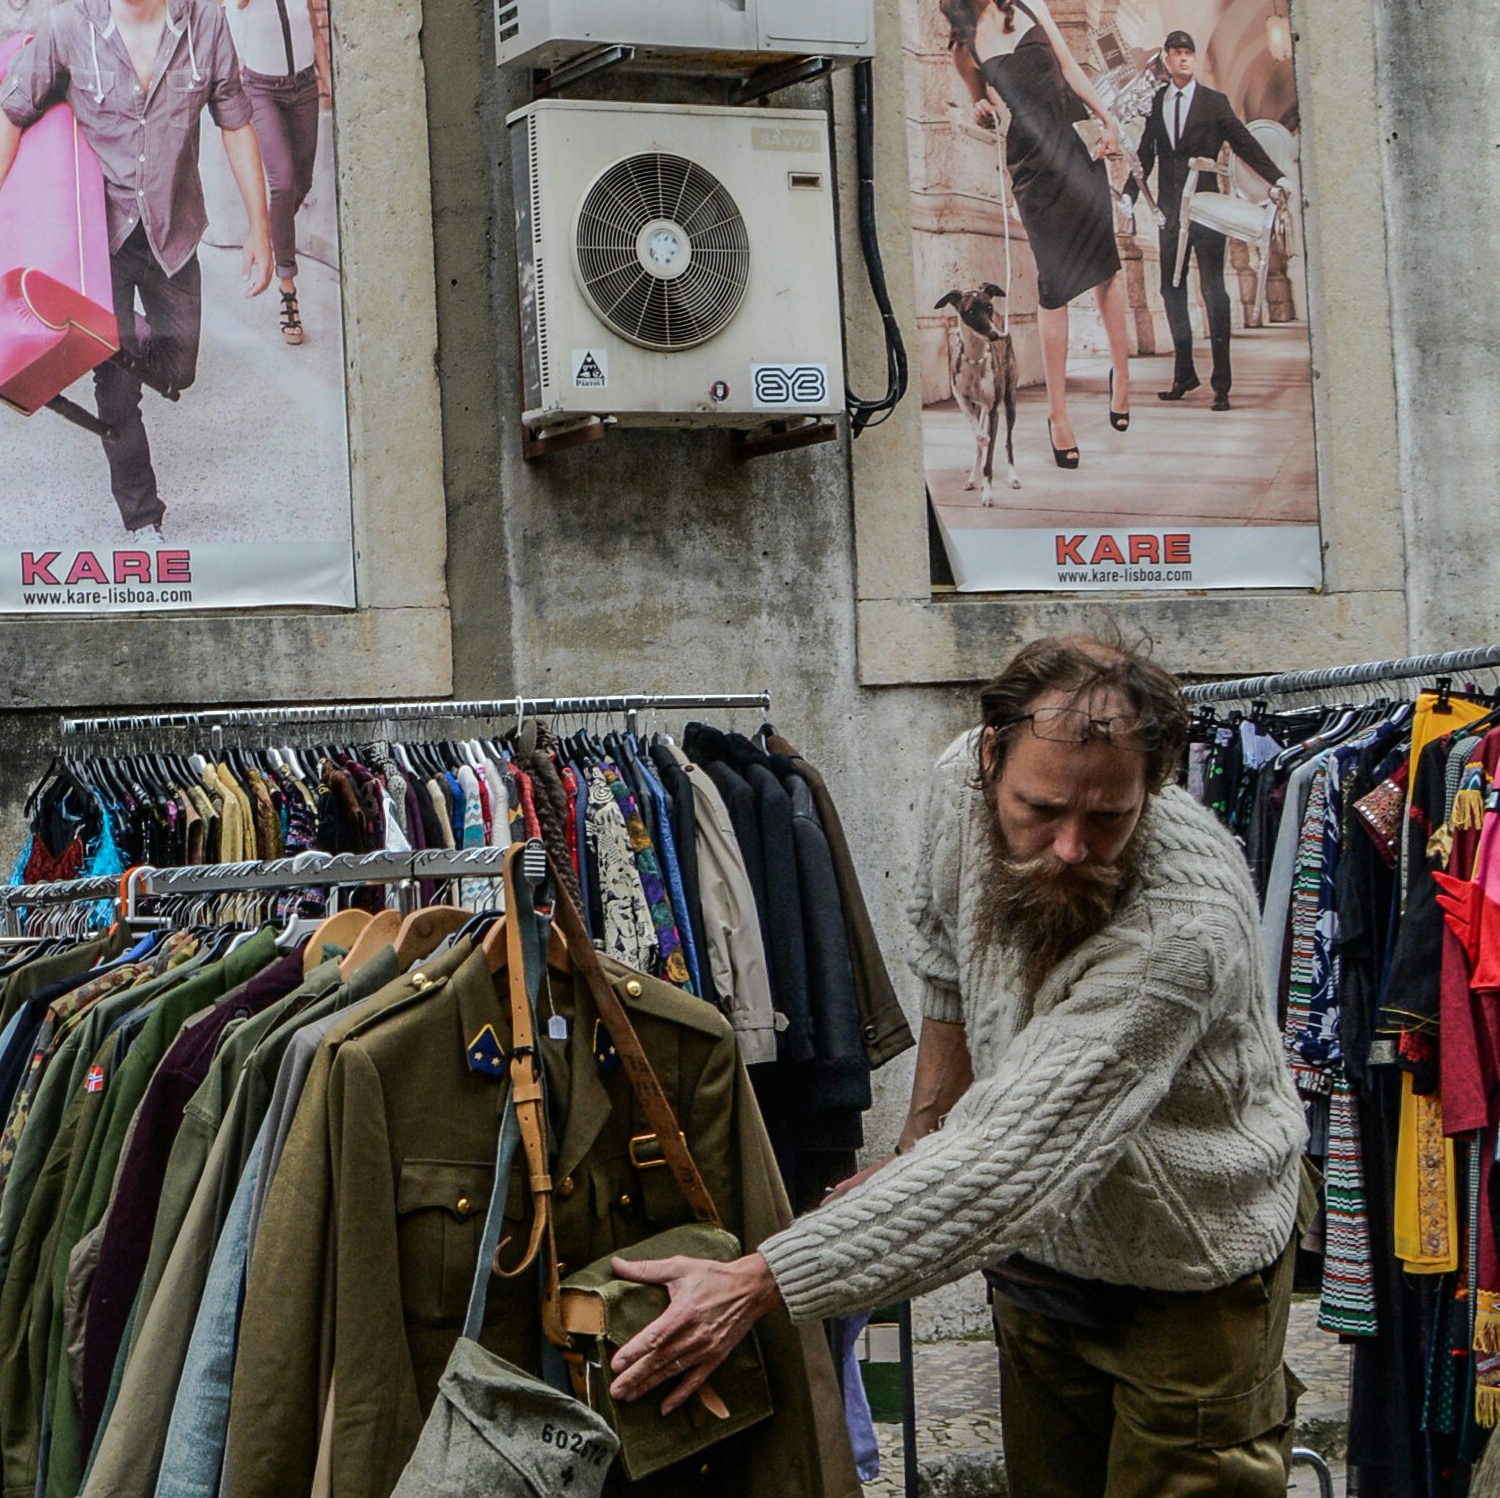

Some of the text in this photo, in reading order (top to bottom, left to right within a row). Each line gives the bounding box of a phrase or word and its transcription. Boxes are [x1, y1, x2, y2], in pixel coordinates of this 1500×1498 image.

[1055, 534, 1192, 565] KARE
[21, 550, 192, 585] KARE
[1058, 567, 1193, 583] www.kare-lisboa.com
[23, 588, 192, 605] www.kare-lisboa.com
